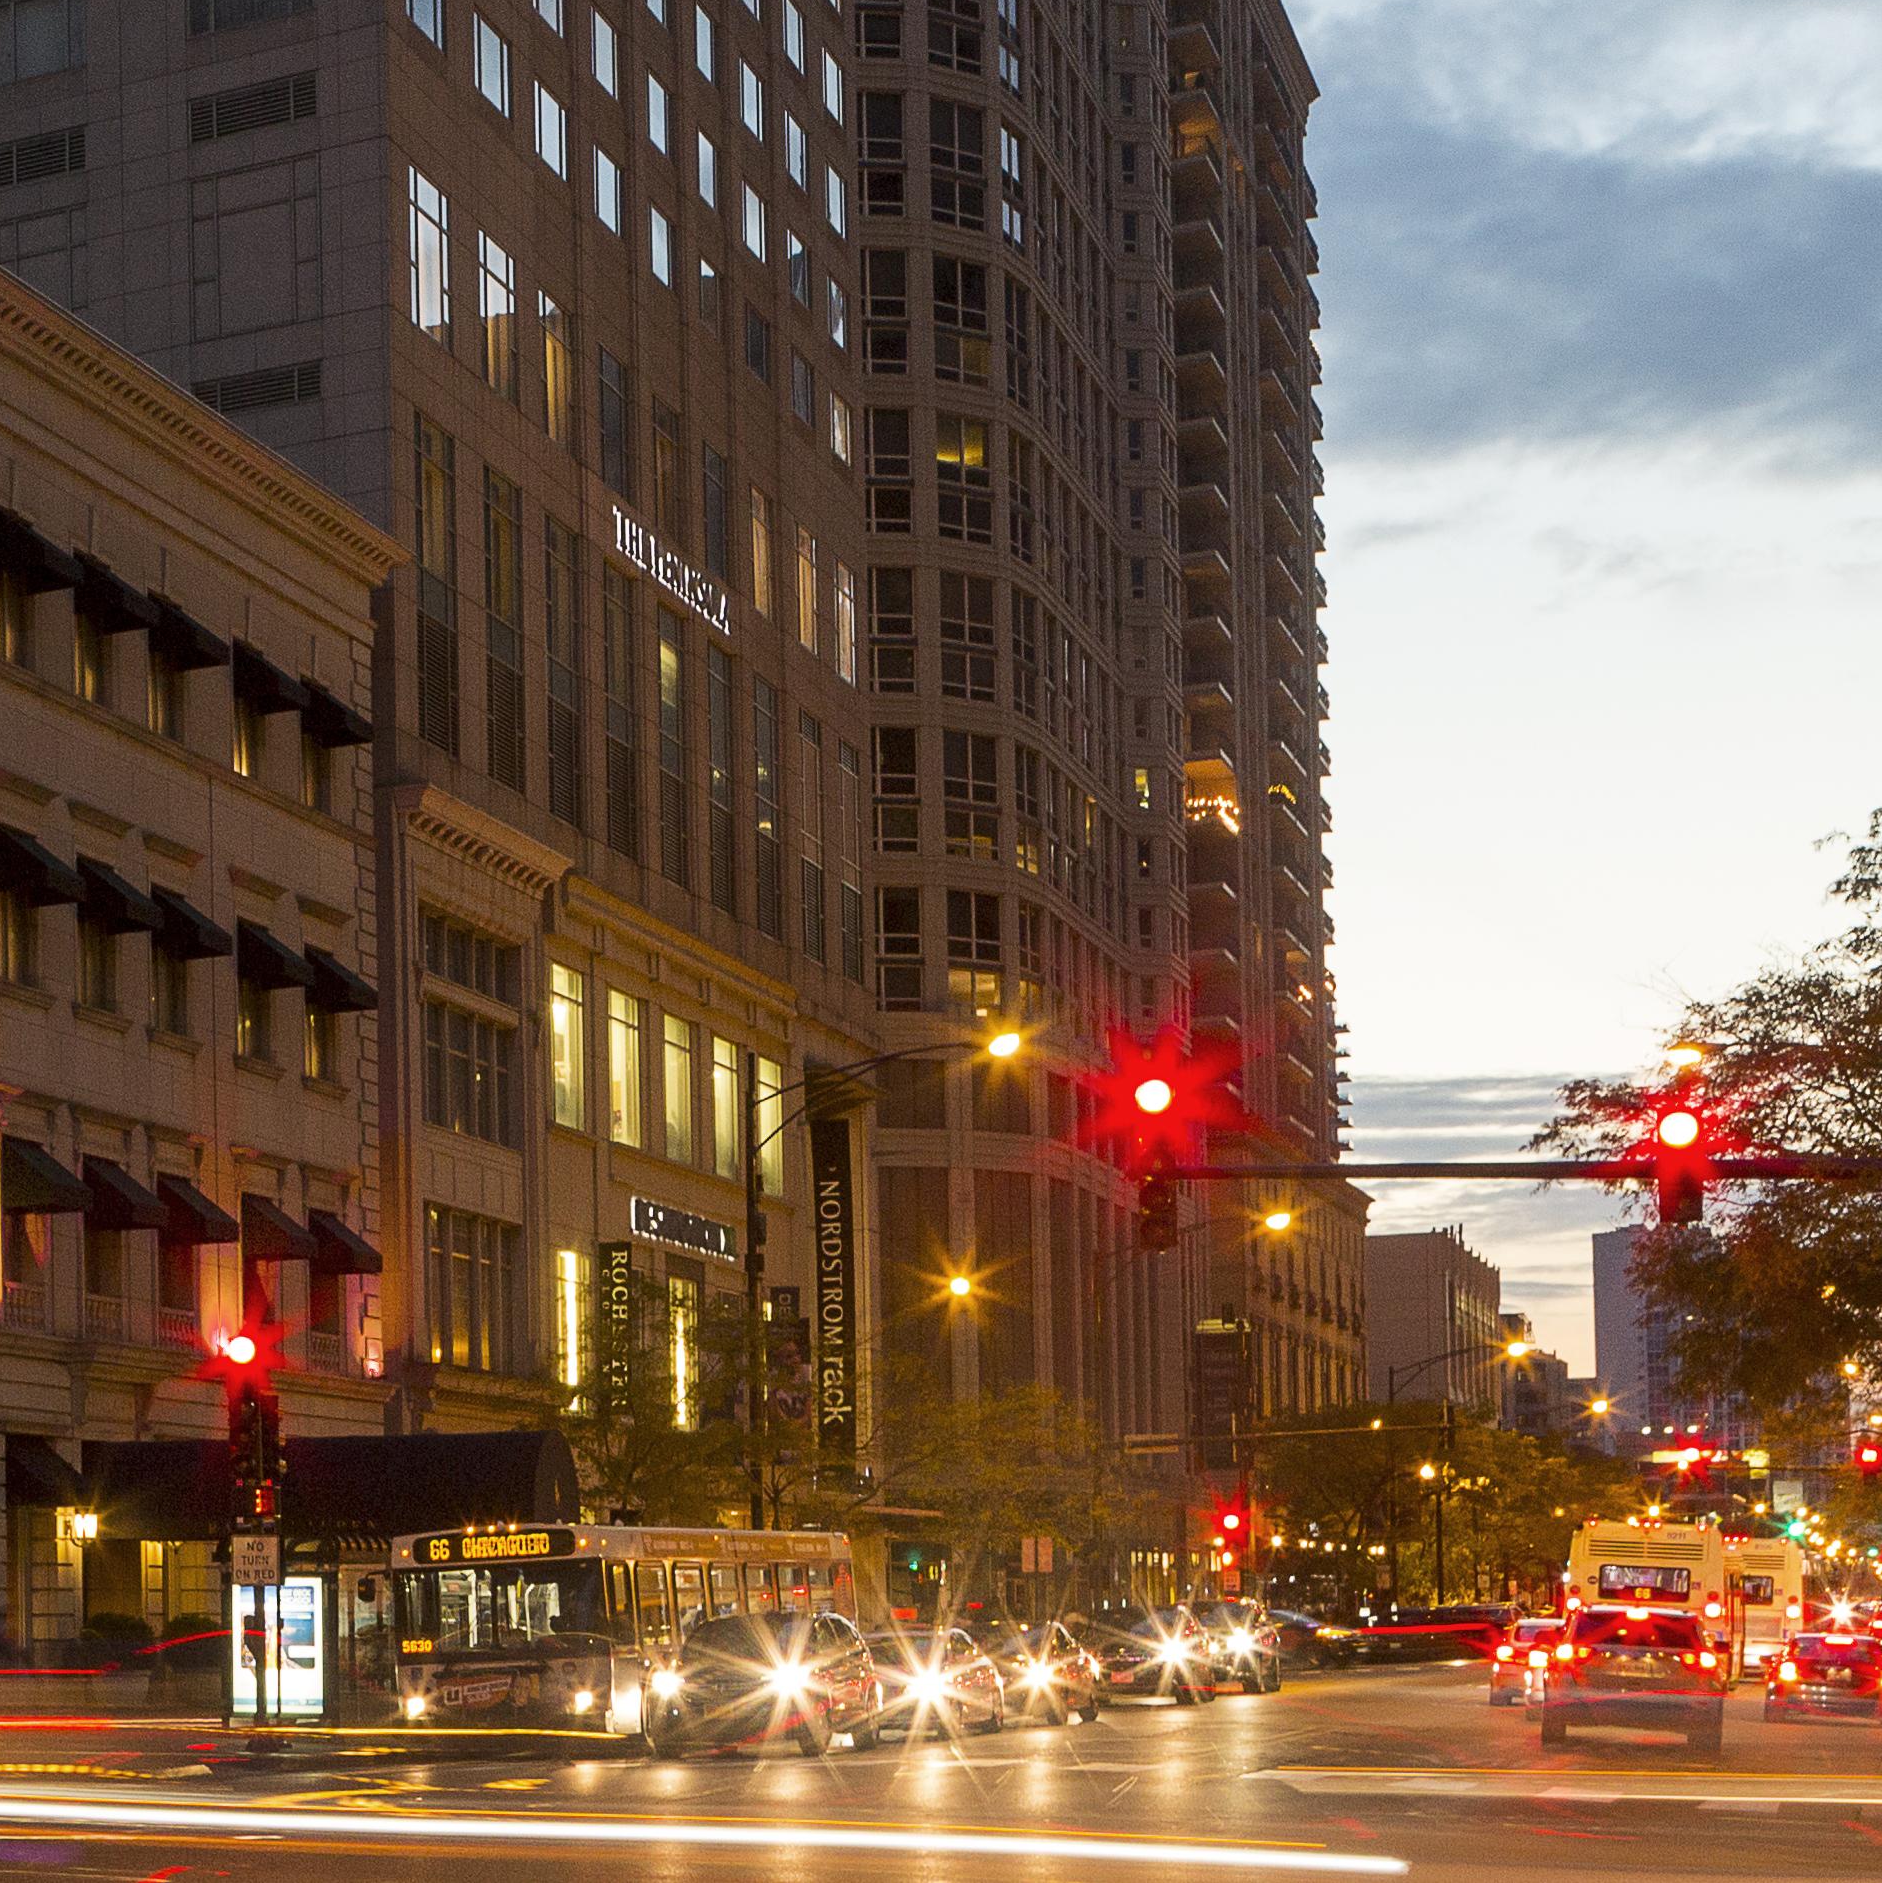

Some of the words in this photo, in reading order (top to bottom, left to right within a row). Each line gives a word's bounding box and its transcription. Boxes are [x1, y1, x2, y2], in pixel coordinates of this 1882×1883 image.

[818, 1180, 844, 1346] NORDSTROM
[822, 1352, 853, 1426] rack
[246, 1541, 264, 1552] NO
[429, 1538, 450, 1561] 66
[241, 1555, 270, 1566] TURN
[235, 1569, 251, 1580] ON
[253, 1569, 275, 1580] RED
